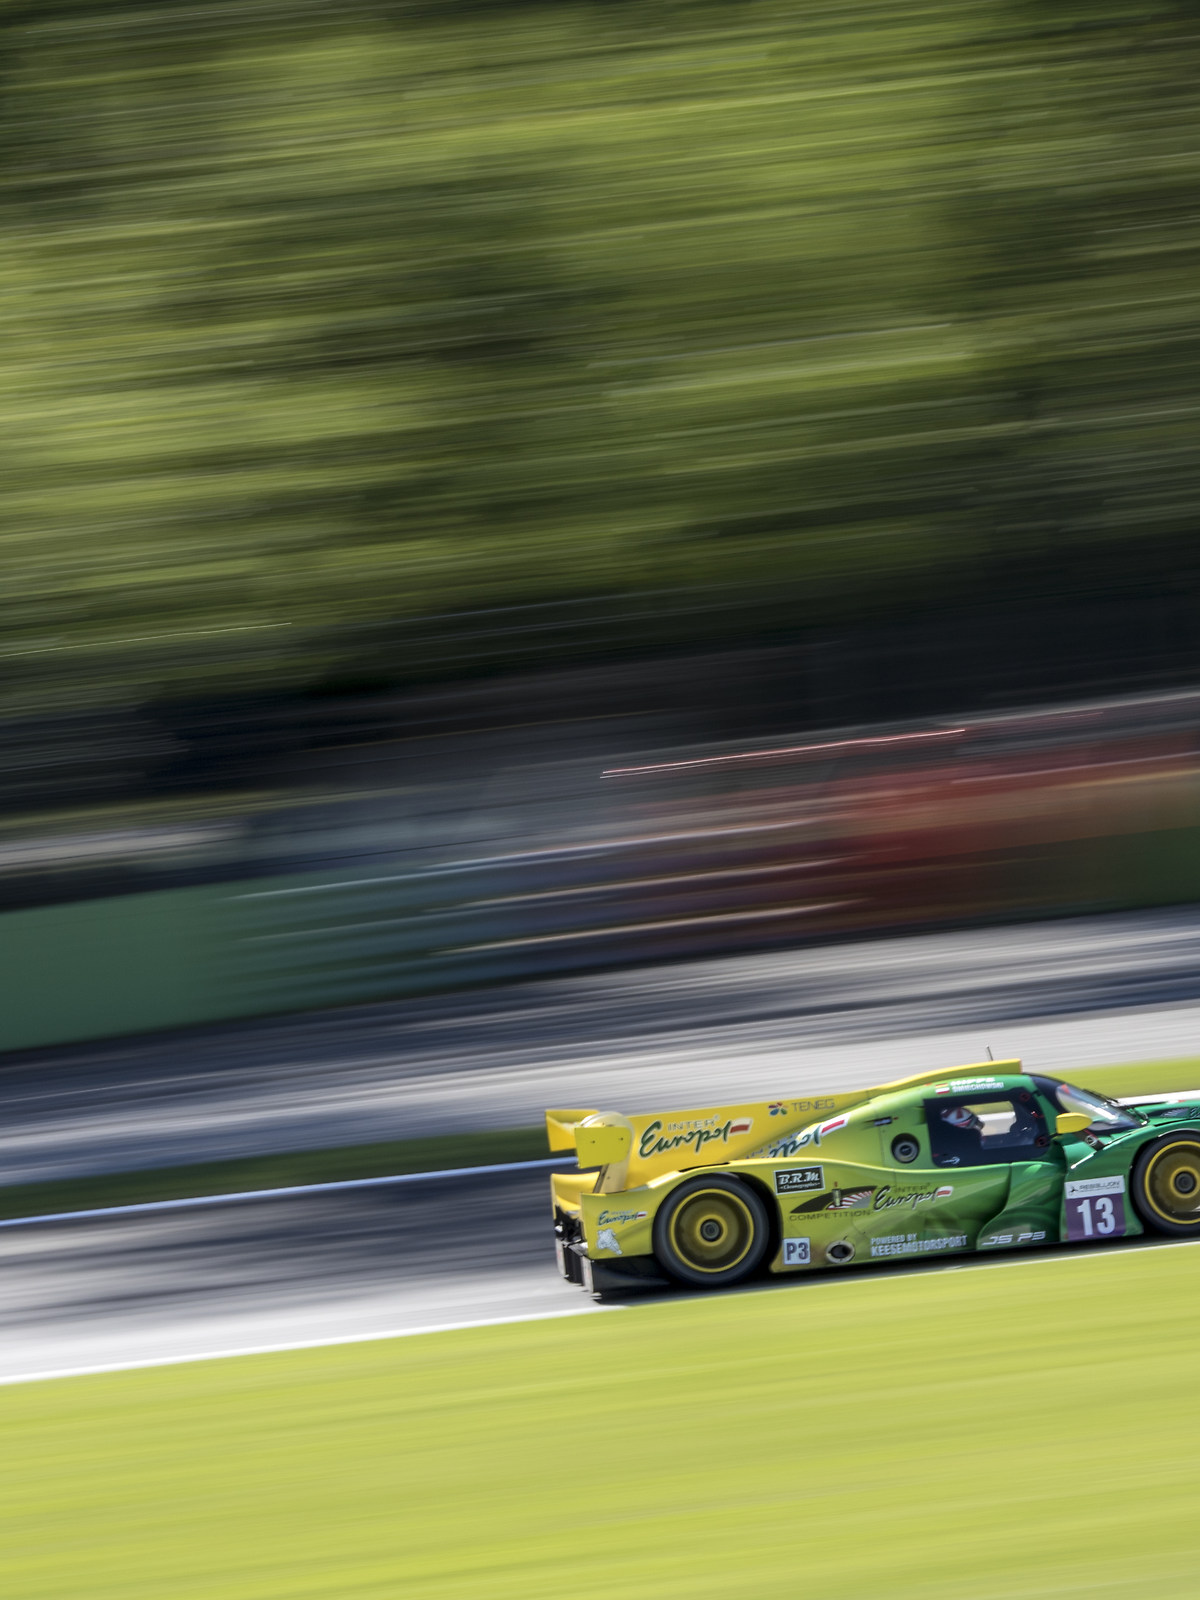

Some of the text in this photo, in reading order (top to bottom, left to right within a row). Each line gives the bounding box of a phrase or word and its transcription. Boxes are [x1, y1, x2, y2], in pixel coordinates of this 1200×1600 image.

[667, 1119, 715, 1132] INTER
[639, 1120, 731, 1158] Europol
[874, 1185, 938, 1211] Europol
[789, 1209, 871, 1221] COMPETITION
[1077, 1197, 1115, 1235] 13
[870, 1233, 917, 1245] POWERED BY
[1016, 1231, 1046, 1242] P3
[786, 1242, 809, 1260] P3
[871, 1235, 968, 1257] KEESEMOTORSPORT
